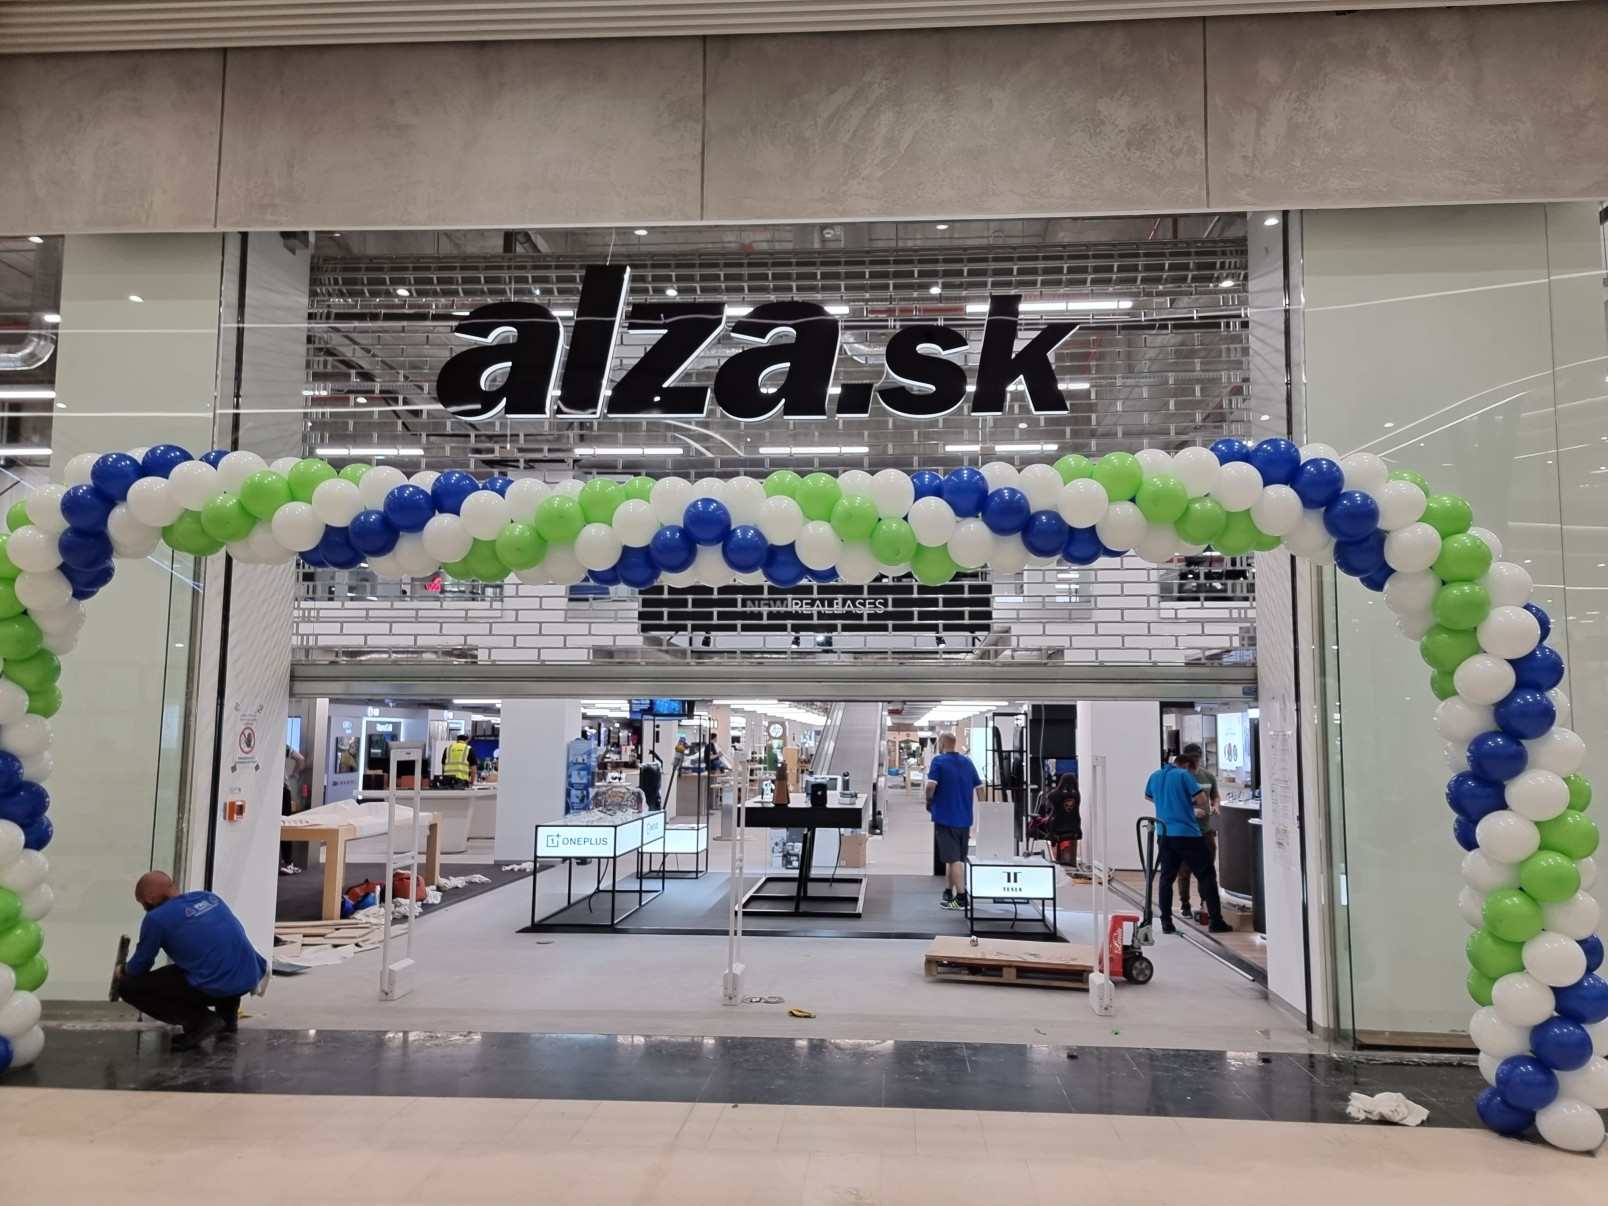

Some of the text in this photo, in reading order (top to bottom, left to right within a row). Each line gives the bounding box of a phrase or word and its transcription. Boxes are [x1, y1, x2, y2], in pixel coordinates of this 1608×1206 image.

[436, 265, 1080, 421] alza.sk
[746, 599, 885, 614] NEW REALEASES
[562, 837, 608, 846] ONEPLUS
